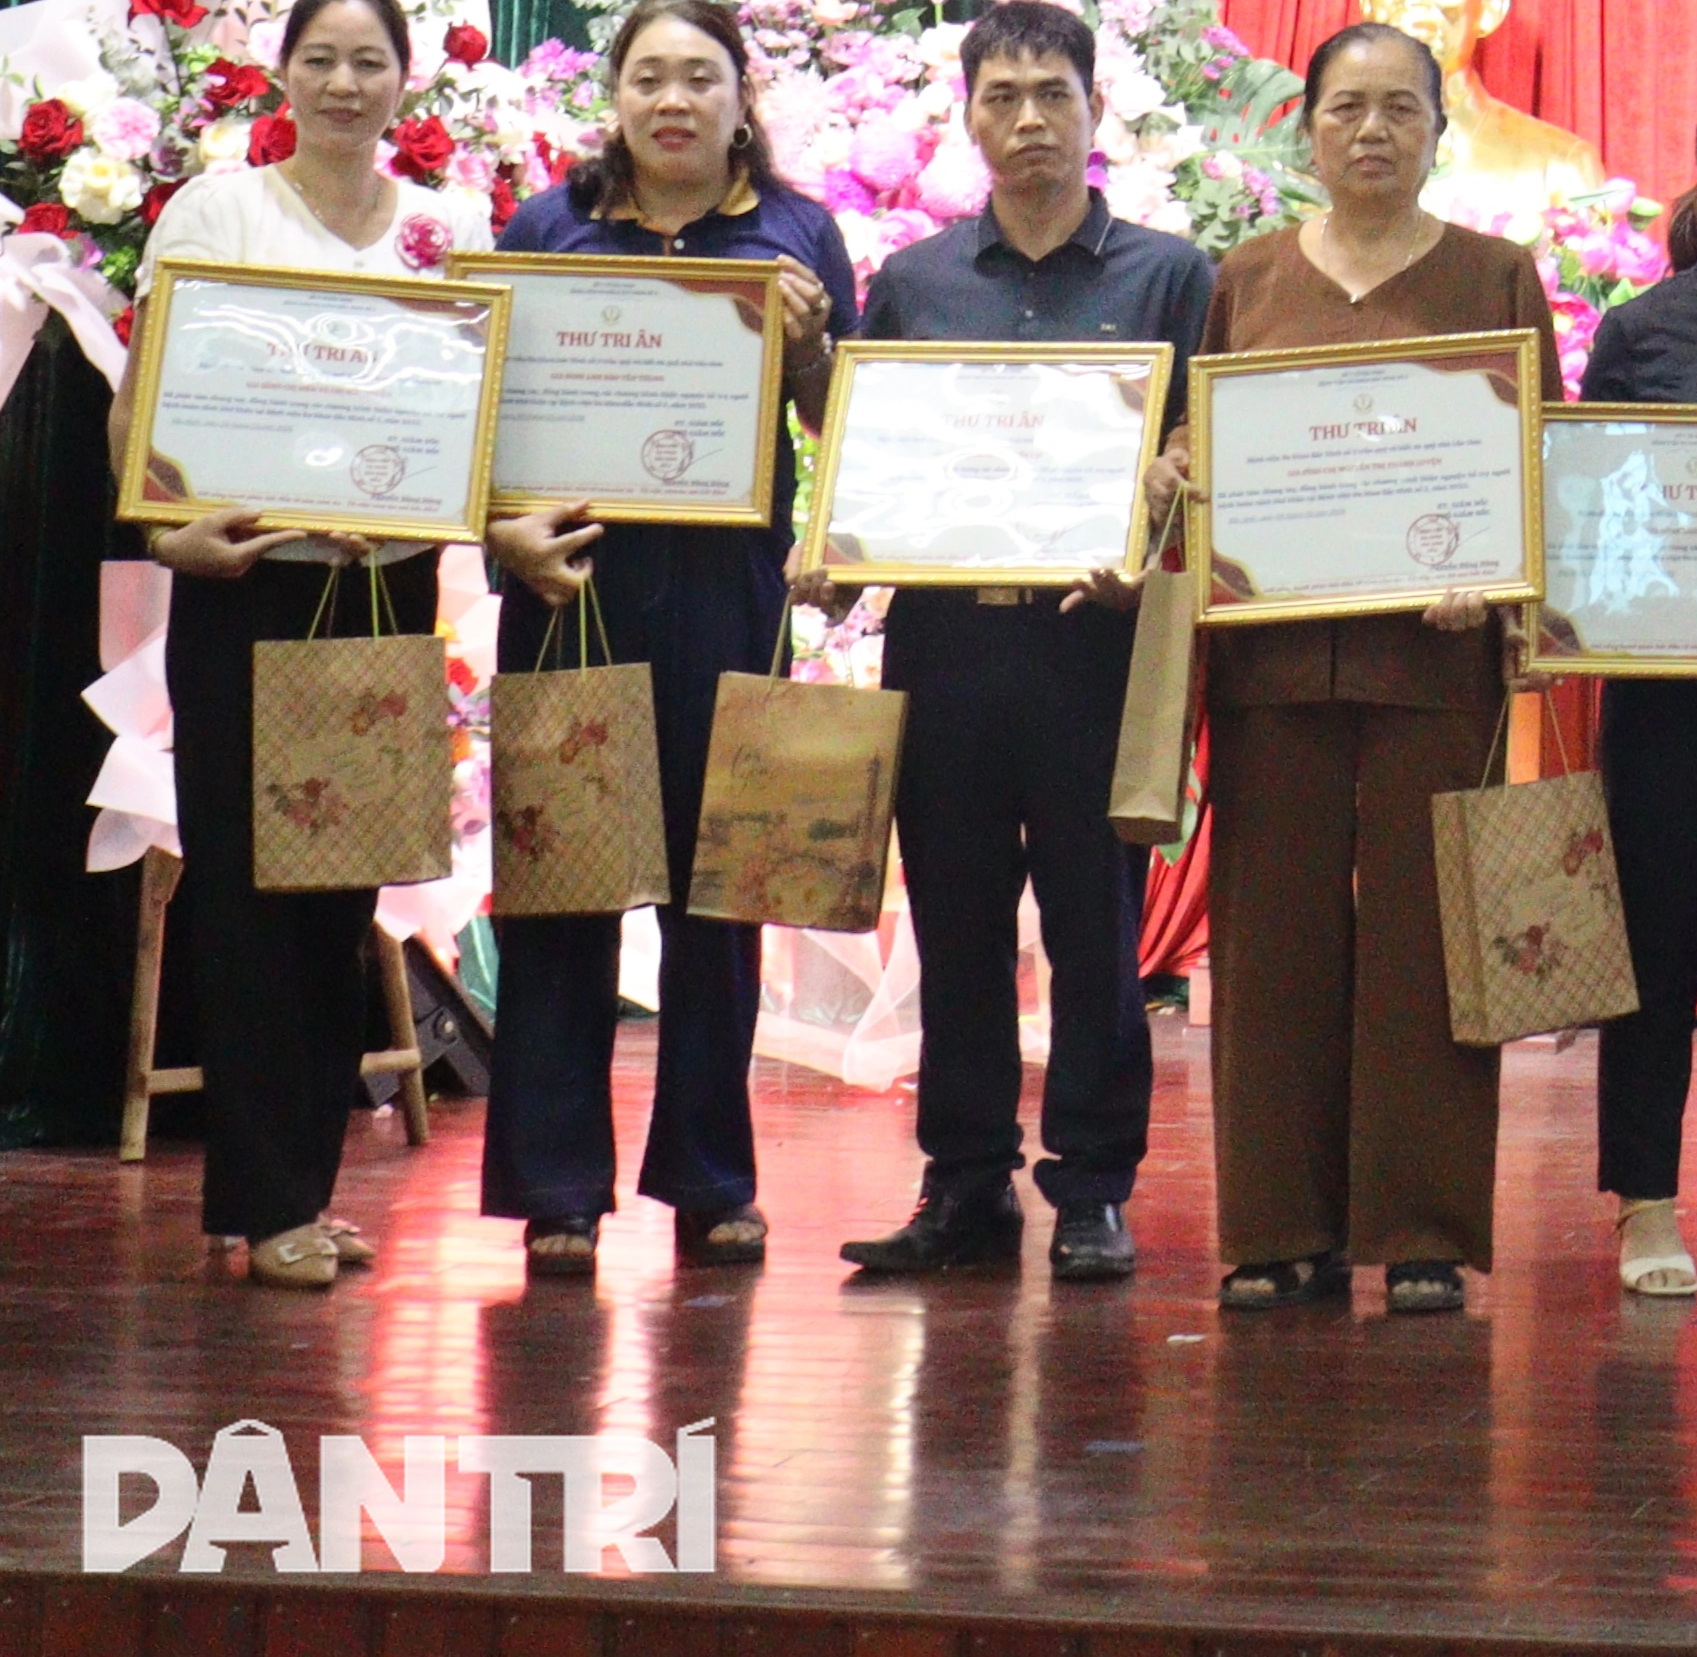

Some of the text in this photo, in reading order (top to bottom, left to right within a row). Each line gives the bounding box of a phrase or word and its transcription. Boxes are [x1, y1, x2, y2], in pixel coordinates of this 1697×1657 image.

[557, 328, 663, 350] THƯ TRI ÂN
[1309, 422, 1350, 441] THƯ
